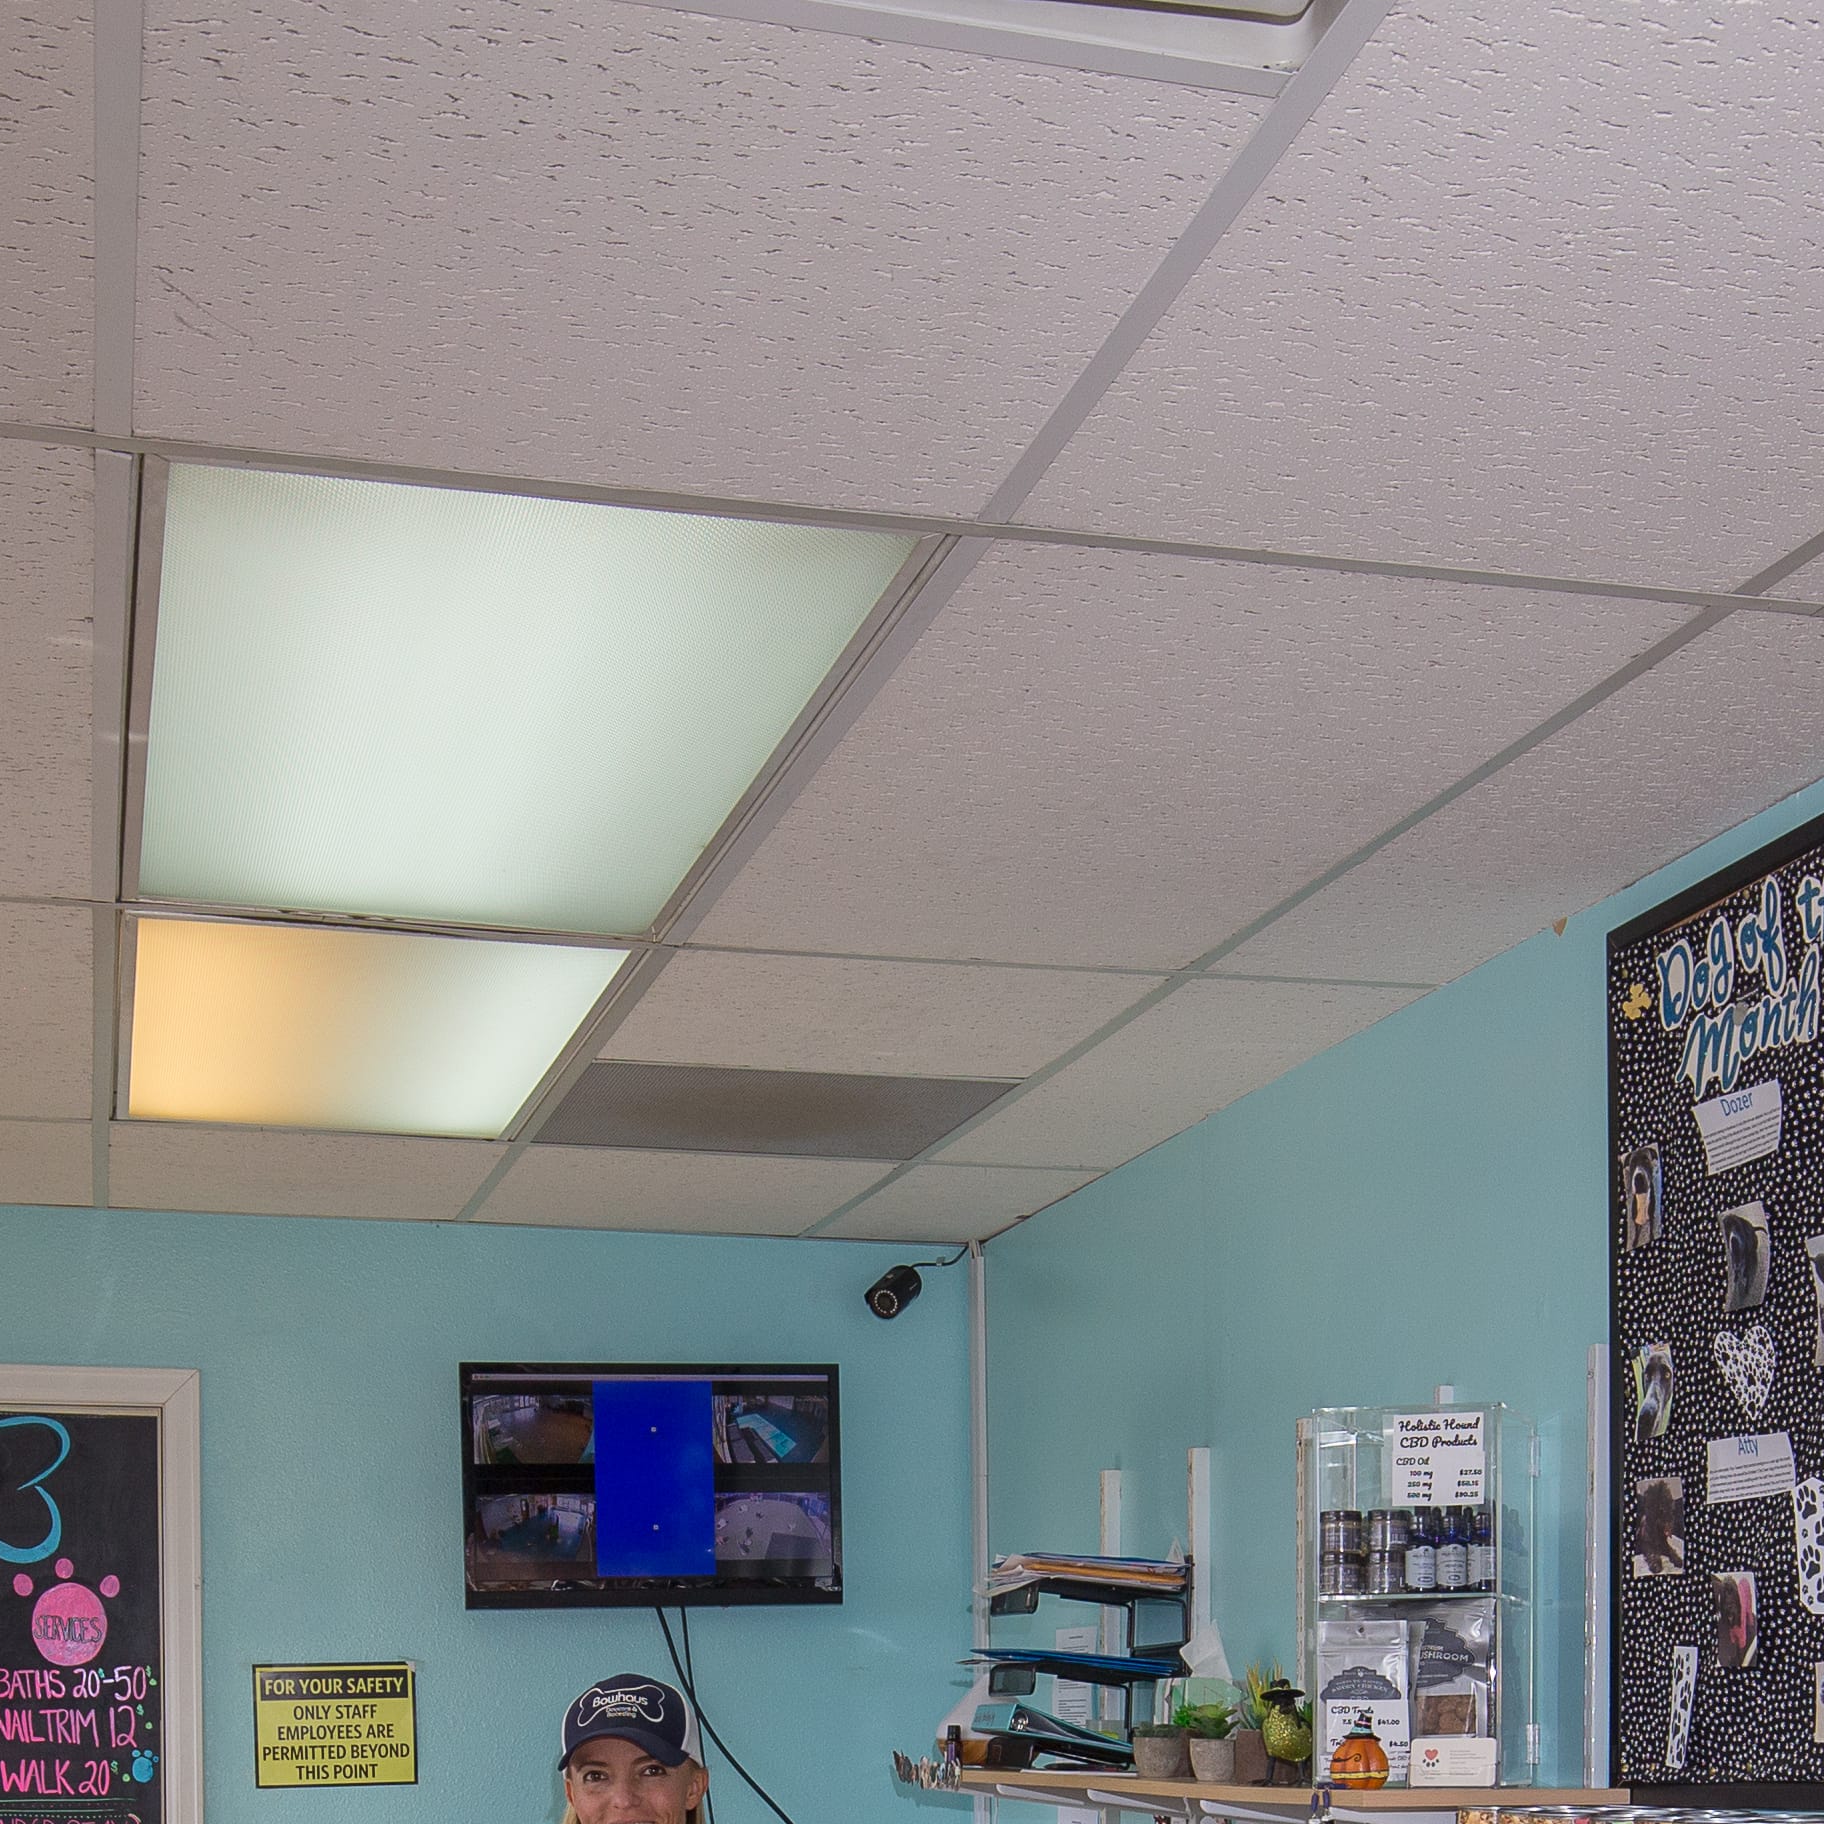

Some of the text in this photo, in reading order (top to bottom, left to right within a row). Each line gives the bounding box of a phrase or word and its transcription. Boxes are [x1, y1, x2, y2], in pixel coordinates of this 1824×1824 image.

[1721, 1090, 1754, 1117] Dozer
[1399, 1417, 1480, 1432] Holistic Hound
[1400, 1434, 1478, 1448] CBD Products
[1737, 1436, 1759, 1457] Atty
[1396, 1458, 1415, 1466] CBD
[34, 1615, 102, 1643] SERVICES
[265, 1677, 404, 1695] FOR YOUR SAFETY
[593, 1692, 648, 1708] Bowhaus
[294, 1704, 377, 1720] ONLY STAFF
[278, 1724, 394, 1741] EMPLOYEES ARE
[263, 1743, 410, 1761] PERMITTED BEYOND
[0, 1759, 75, 1795] WALK
[296, 1764, 378, 1780] THIS POINT
